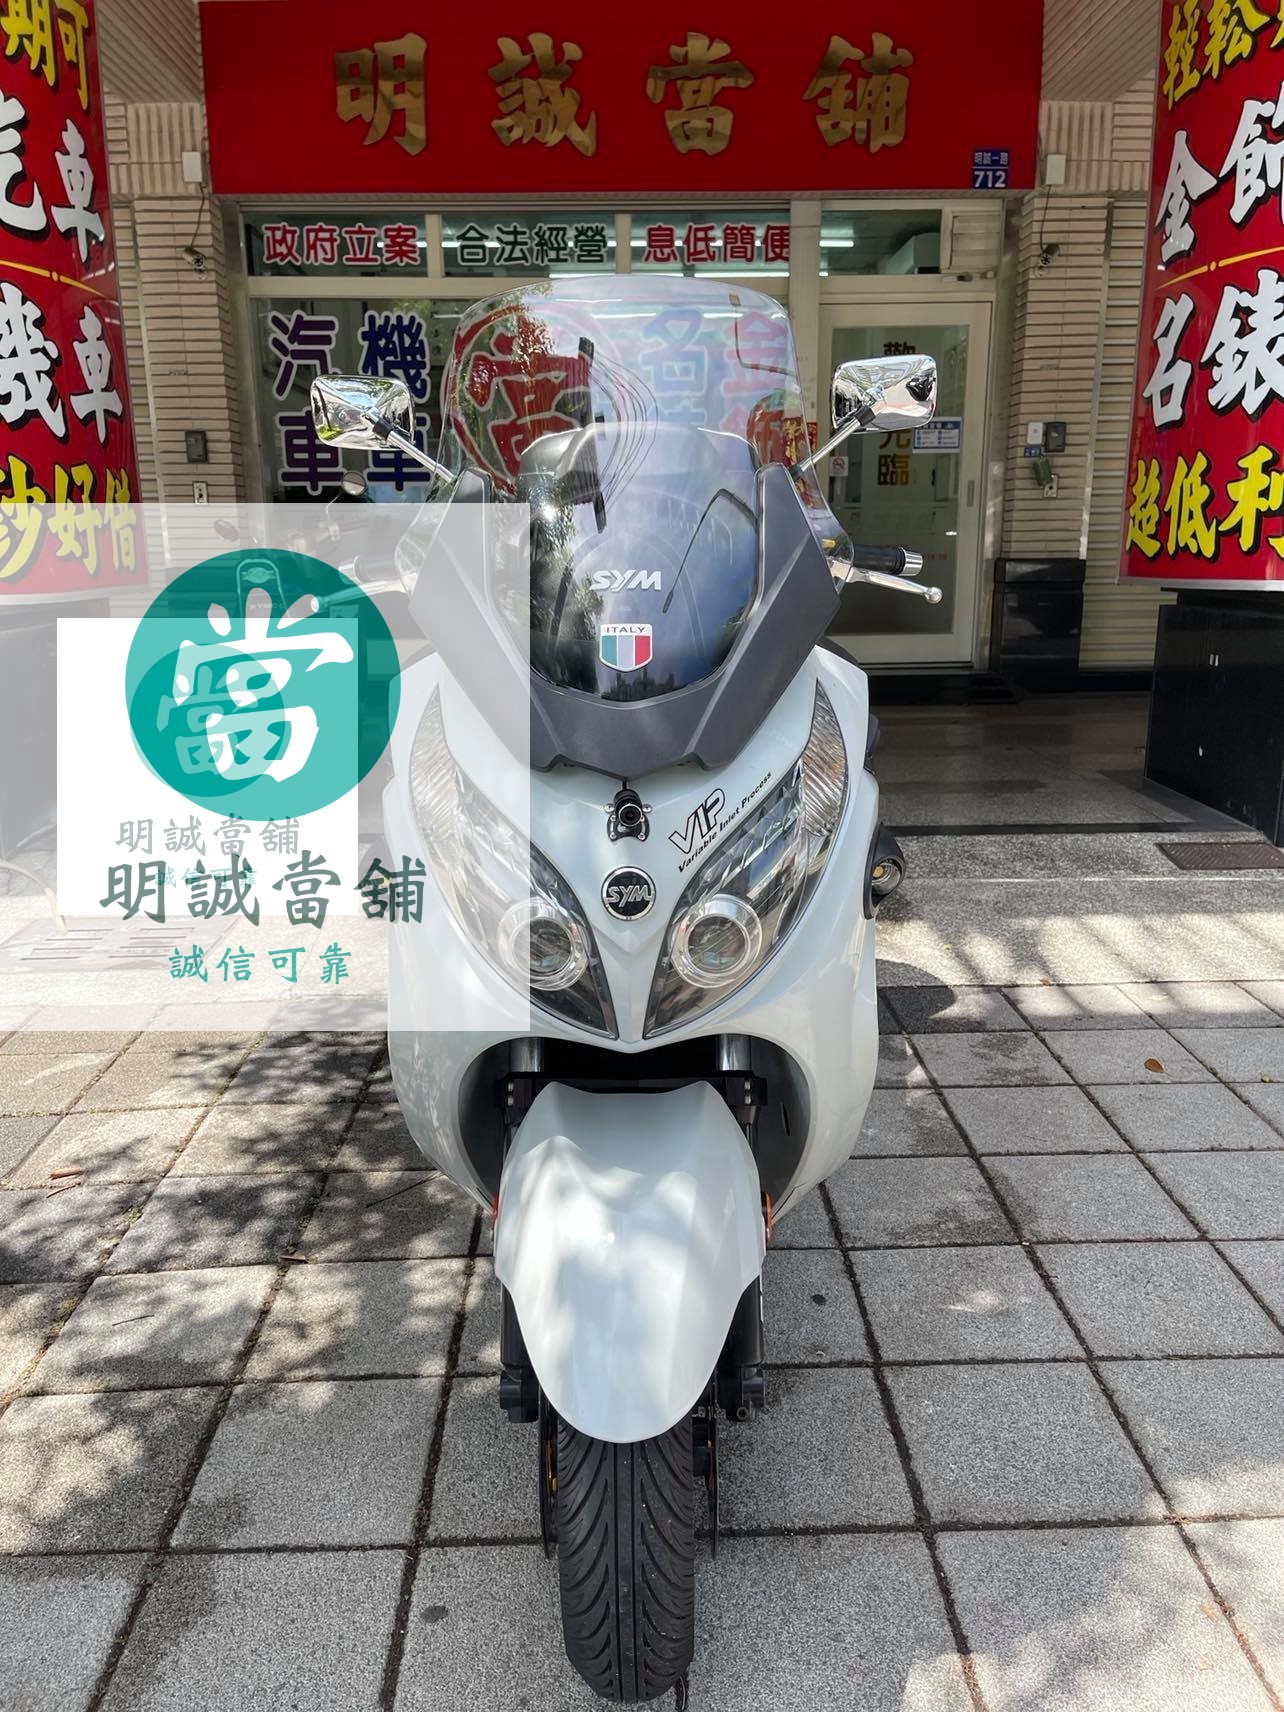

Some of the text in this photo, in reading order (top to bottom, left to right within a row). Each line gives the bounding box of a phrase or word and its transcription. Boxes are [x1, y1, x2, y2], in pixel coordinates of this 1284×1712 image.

[973, 170, 1006, 188] 712
[262, 223, 421, 265] 政府立案
[455, 224, 608, 265] 合法經營
[643, 223, 790, 264] 息低簡便
[590, 569, 662, 592] SYM
[668, 788, 725, 854] VIP
[679, 772, 771, 872] Variable Inlet Process
[605, 885, 653, 907] SYM
